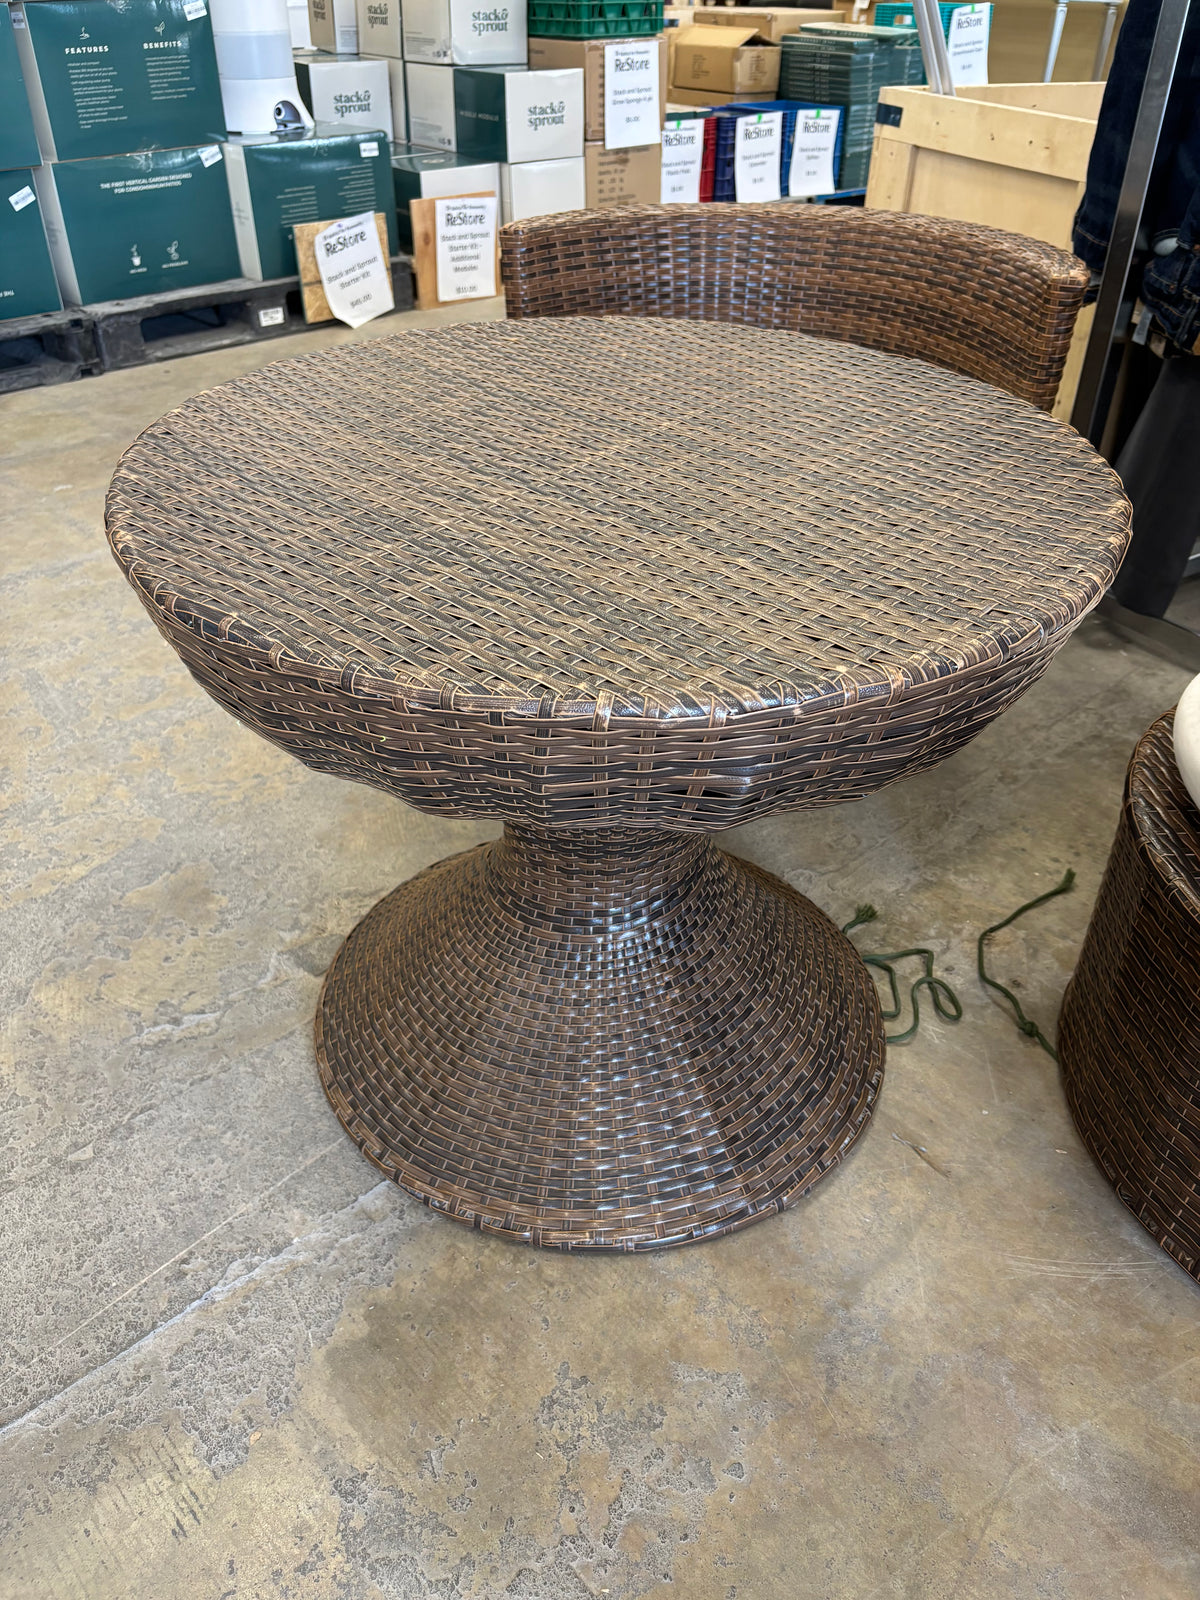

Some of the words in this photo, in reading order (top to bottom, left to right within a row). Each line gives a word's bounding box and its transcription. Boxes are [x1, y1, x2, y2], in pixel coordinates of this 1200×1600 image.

[368, 15, 389, 28] sprout
[957, 17, 983, 29] ReStore
[471, 21, 508, 36] sprout
[64, 45, 109, 55] FEATURES
[142, 40, 182, 50] BENEFITS
[614, 57, 650, 72] ReStore
[334, 102, 371, 117] sprout
[528, 114, 565, 131] sprout
[803, 121, 831, 133] ReStore
[664, 134, 696, 147] ReStore
[744, 127, 774, 141] ReStore
[100, 182, 111, 190] THE
[445, 211, 486, 228] ReStore
[323, 229, 367, 257] ReStore
